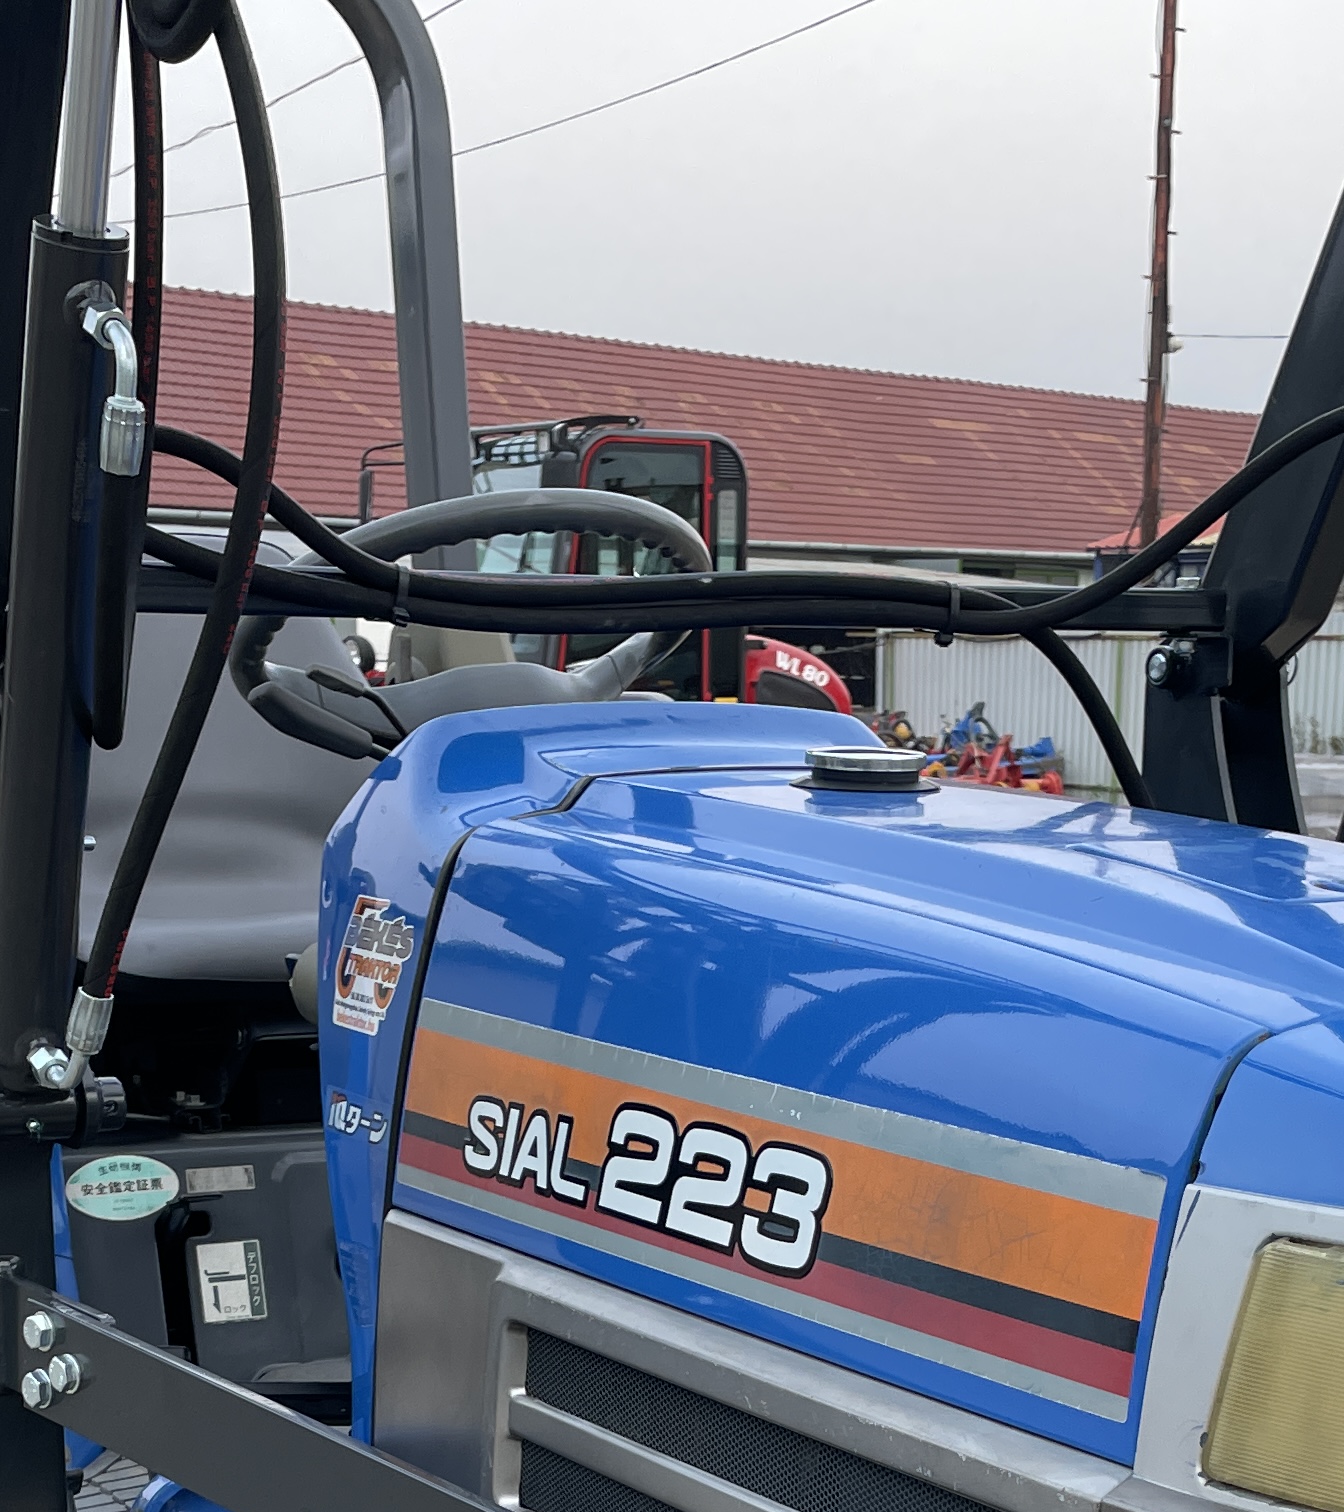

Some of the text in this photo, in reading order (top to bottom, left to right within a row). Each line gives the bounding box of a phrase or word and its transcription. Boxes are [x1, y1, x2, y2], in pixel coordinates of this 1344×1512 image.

[463, 1096, 833, 1278] SIAL 223
[247, 1251, 261, 1306] デフロック
[224, 1304, 247, 1313] ロック
